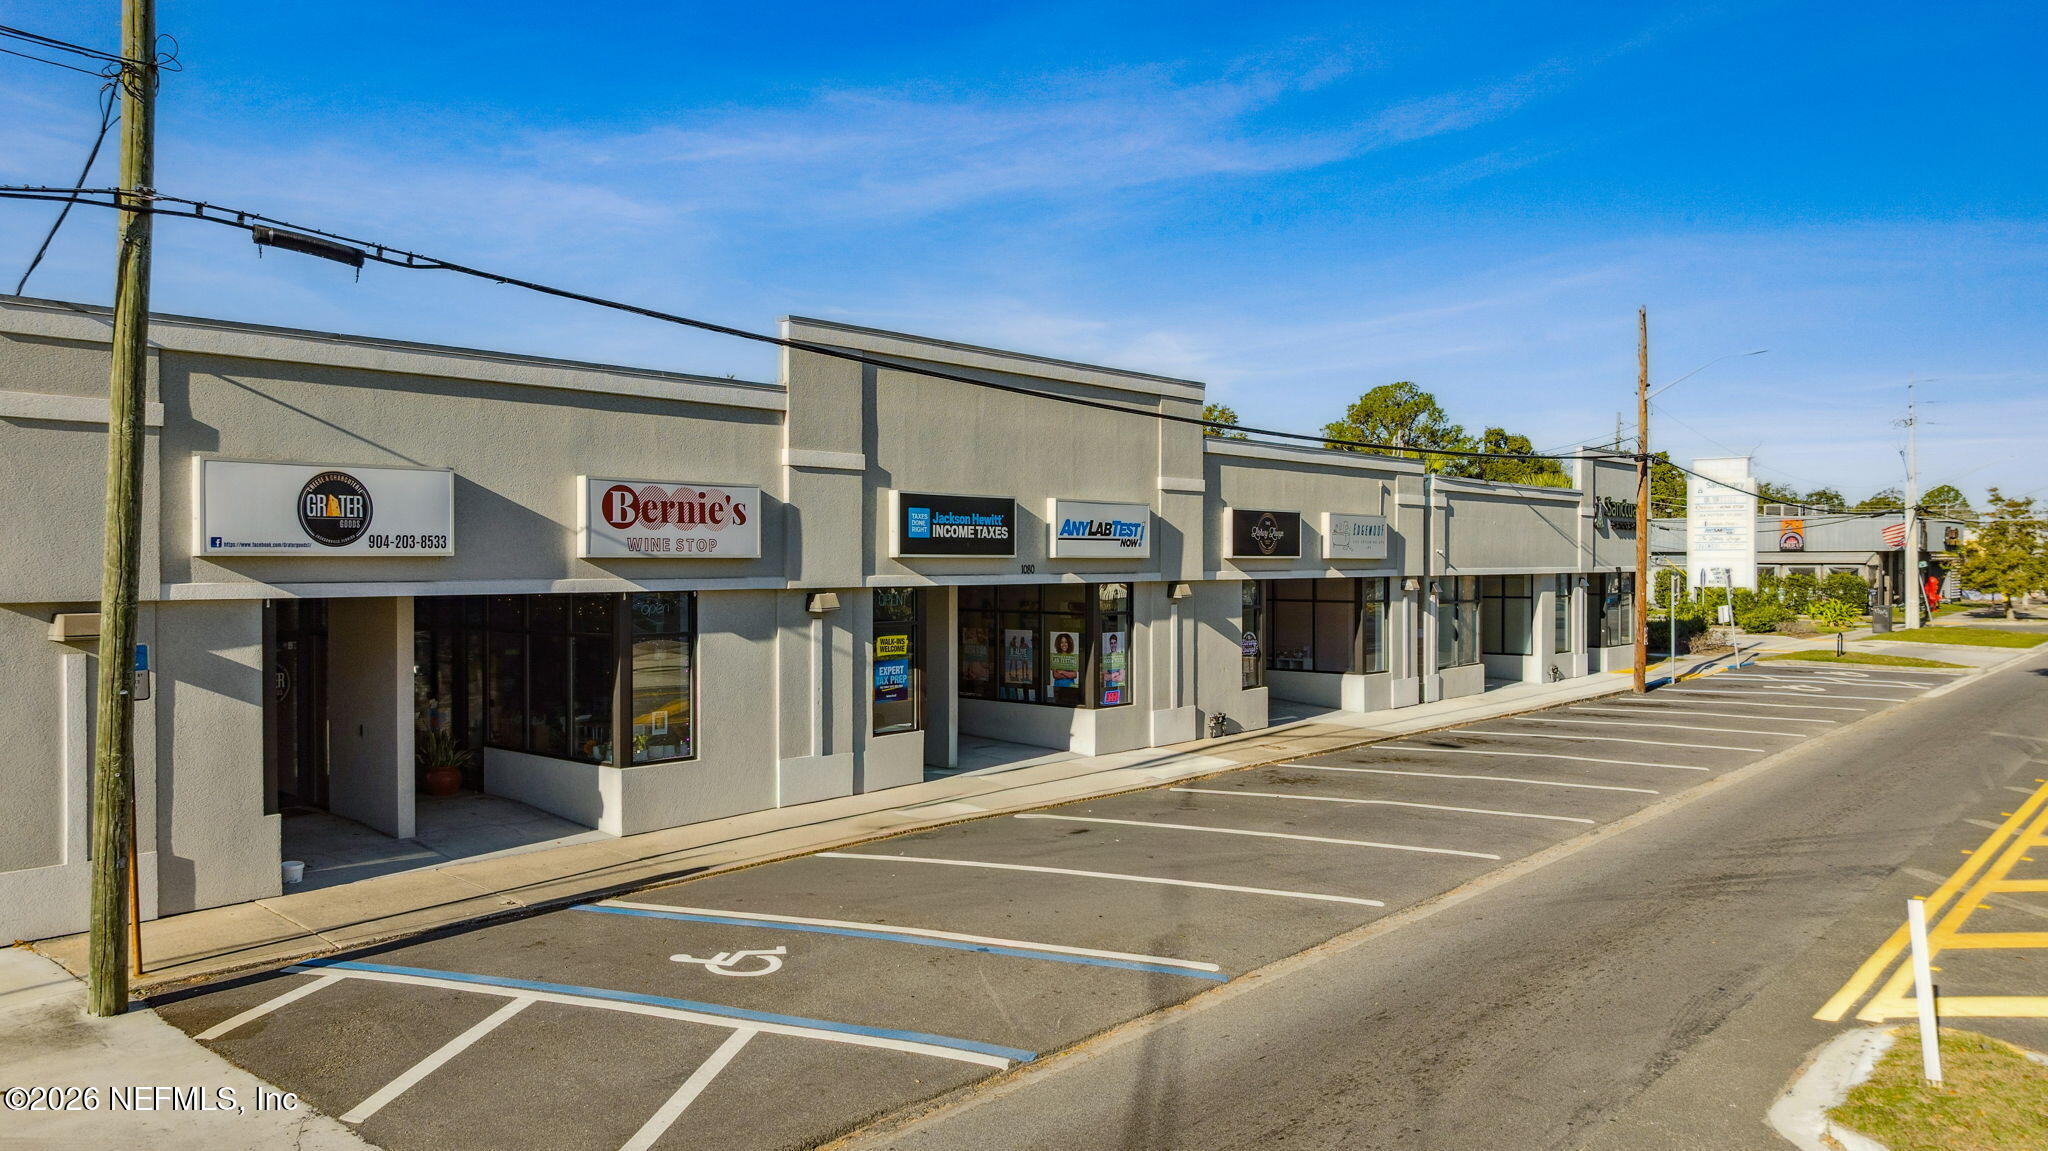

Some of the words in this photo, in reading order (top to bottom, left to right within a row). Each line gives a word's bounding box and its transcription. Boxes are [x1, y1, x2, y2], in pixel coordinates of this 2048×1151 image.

[609, 490, 747, 526] Bernie's
[1604, 496, 1637, 518] Sanctua
[339, 519, 361, 528] GOODS
[932, 511, 971, 525] Jackson
[932, 524, 975, 538] INCOME
[976, 525, 1008, 538] TAXES
[368, 534, 447, 549] 904-203-8533
[627, 537, 671, 552] WINE
[675, 538, 718, 552] STOP
[880, 638, 905, 646] WALK-INS
[880, 645, 905, 653] WELCOME
[879, 665, 905, 676] EXPERT
[890, 674, 908, 684] PREP
